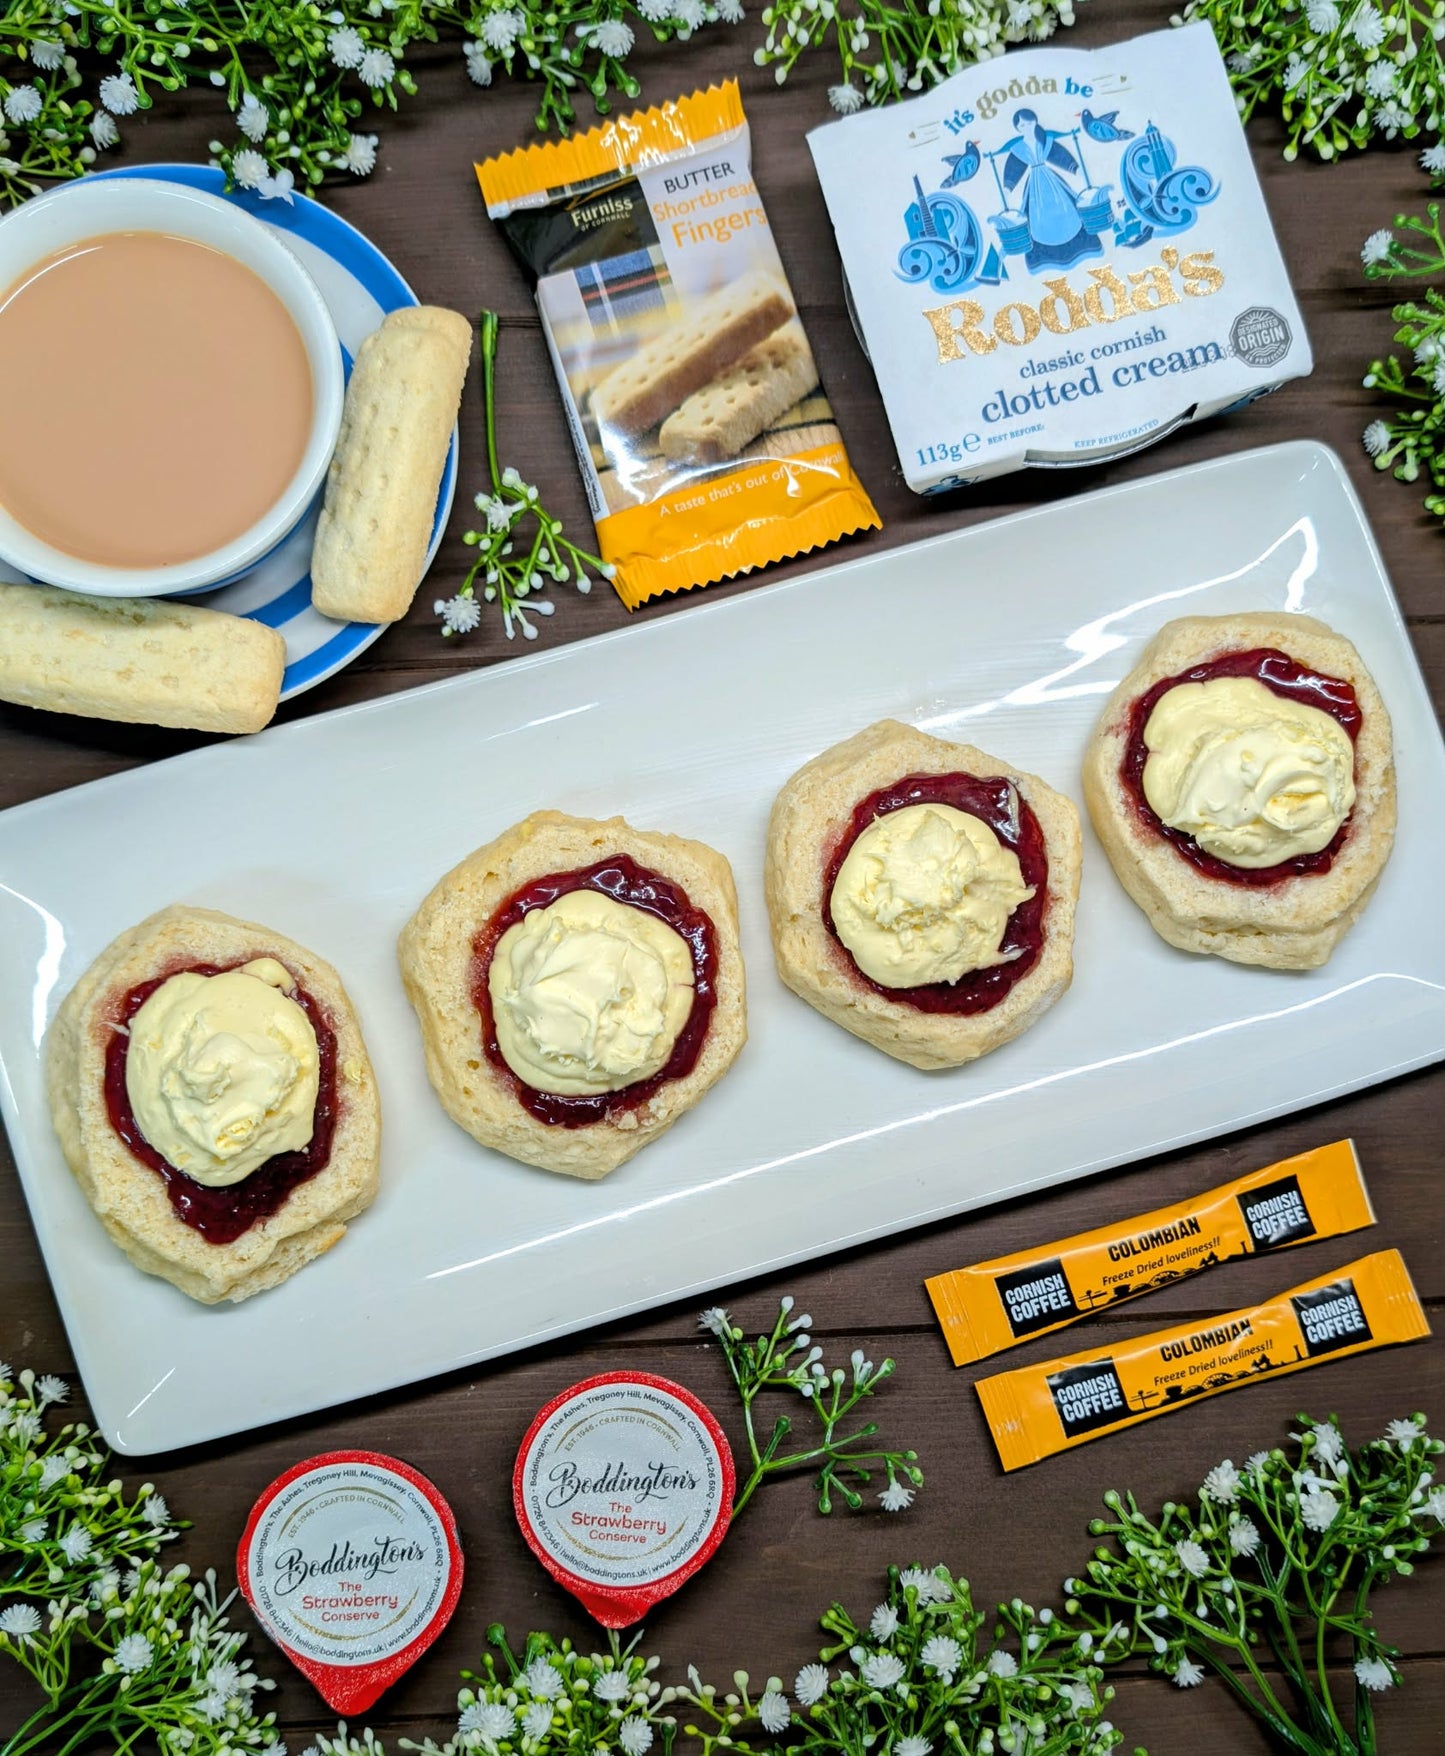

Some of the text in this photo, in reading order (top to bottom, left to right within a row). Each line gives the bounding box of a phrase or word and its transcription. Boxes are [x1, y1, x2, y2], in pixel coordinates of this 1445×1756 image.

[943, 109, 975, 136] it's
[1064, 77, 1093, 97] be
[664, 162, 735, 193] BUTTER
[571, 197, 633, 227] Furniss
[592, 212, 630, 227] CORNWALL
[672, 207, 768, 248] Fingers
[922, 245, 1224, 365] Rodda's
[1237, 319, 1279, 336] DESIGNATED
[1238, 326, 1285, 352] ORIGIN
[1019, 350, 1085, 380] classic
[1090, 325, 1167, 362] cornish
[981, 367, 1102, 424] clotted
[1111, 341, 1224, 389] cream
[987, 433, 1008, 445] BEST
[1074, 419, 1160, 449] KEEP REFRIGERATED
[916, 442, 962, 467] 113g
[660, 504, 670, 517] A
[674, 494, 705, 513] taste
[709, 481, 742, 503] that's
[745, 475, 768, 491] out
[771, 465, 786, 482] of
[1246, 1190, 1302, 1223] CORNISH
[1108, 1216, 1201, 1263] COLOMBIAN
[1251, 1205, 1310, 1245] COFFEE
[1102, 1236, 1221, 1287] Freeze Dried loveliness!!
[1004, 1273, 1065, 1305] CORNISH
[1010, 1287, 1071, 1323] COFFEE
[1300, 1294, 1359, 1327] CORNISH
[1159, 1318, 1254, 1363] COLOMBIAN
[1306, 1310, 1366, 1345] COFFEE
[1154, 1339, 1273, 1387] Freeze Dried loveliness!!
[587, 1391, 625, 1404] Tregoney
[627, 1390, 641, 1399] Hill,
[1056, 1372, 1117, 1405] CORNISH
[563, 1402, 587, 1420] Ashes,
[643, 1393, 687, 1422] Mevagissey,
[1062, 1387, 1123, 1423] COFFEE
[550, 1418, 564, 1432] The
[576, 1423, 595, 1439] 1946
[599, 1415, 635, 1426] CRAFTED
[636, 1417, 645, 1425] IN
[645, 1418, 681, 1453] CORNWALL
[303, 1471, 342, 1489] Tregoney
[706, 1457, 716, 1479] PL26
[281, 1488, 304, 1506] Ashes,
[545, 1461, 701, 1508] Boddington's
[706, 1481, 716, 1499] 6RQ
[269, 1505, 283, 1520] The
[319, 1494, 355, 1509] CRAFTED
[366, 1496, 405, 1525] CORNWALL
[407, 1492, 434, 1526] Cornwall,
[609, 1501, 632, 1514] The
[430, 1526, 441, 1547] PL26
[571, 1511, 667, 1535] Strawberry
[589, 1529, 647, 1544] Conserve
[274, 1536, 429, 1597] Boddington's
[435, 1548, 443, 1567] 6RQ
[302, 1592, 398, 1609] Strawberry
[338, 1581, 362, 1592] The
[321, 1610, 380, 1623] Conserve
